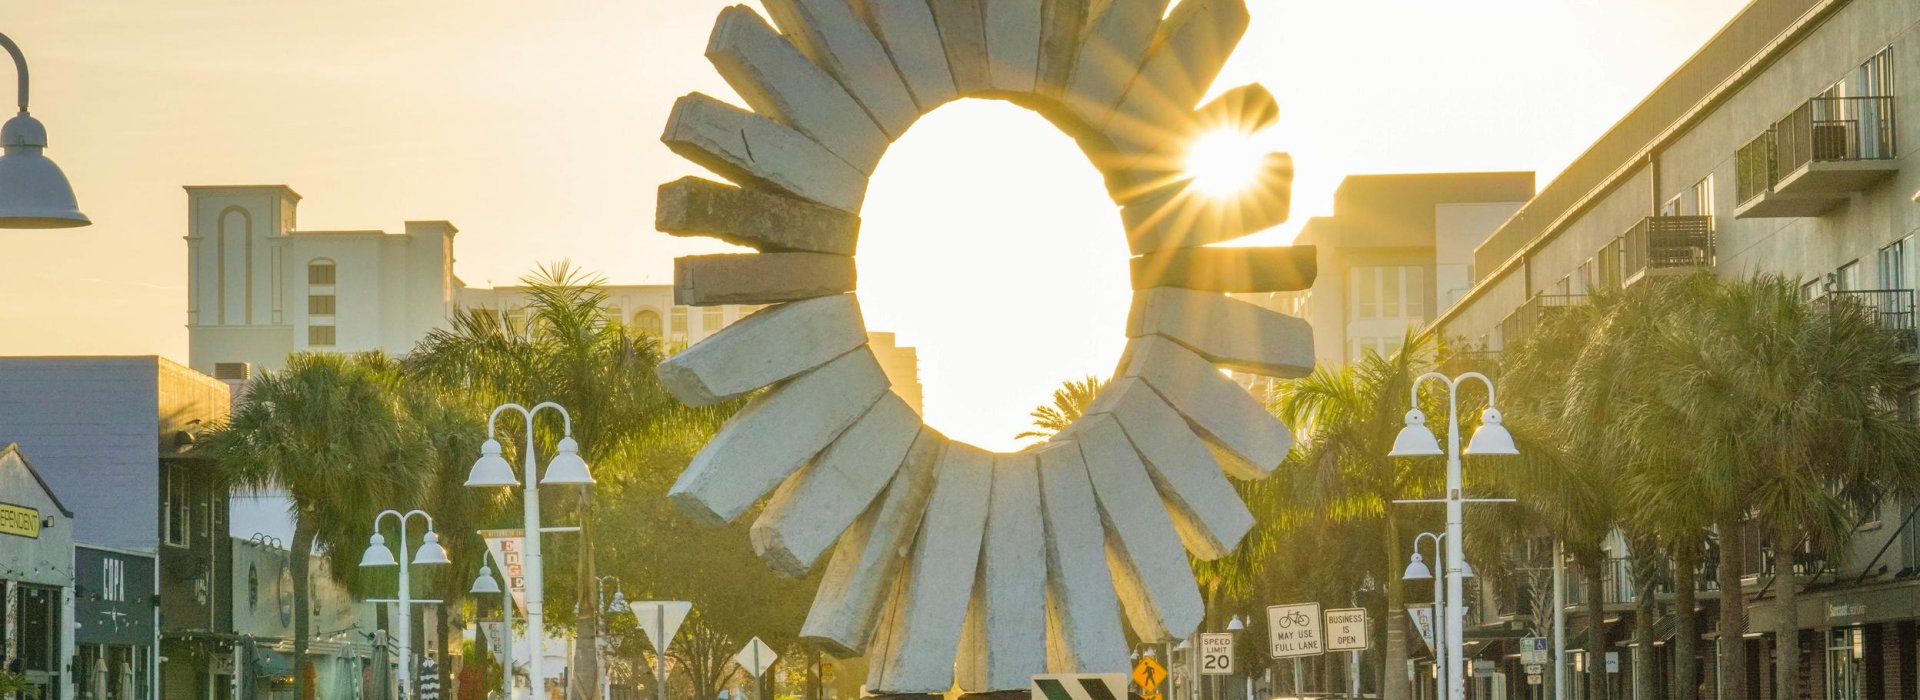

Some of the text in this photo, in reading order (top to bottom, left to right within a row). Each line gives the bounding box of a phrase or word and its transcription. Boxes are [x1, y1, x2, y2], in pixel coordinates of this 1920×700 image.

[103, 558, 125, 602] COPA
[1328, 614, 1363, 624] BUSINESS
[1278, 629, 1313, 641] MAY USE
[1342, 625, 1350, 634] IS
[1203, 638, 1231, 646] SPEED
[1337, 635, 1356, 645] OPEN
[1275, 640, 1319, 652] FULL LANE
[1204, 654, 1230, 669] 20
